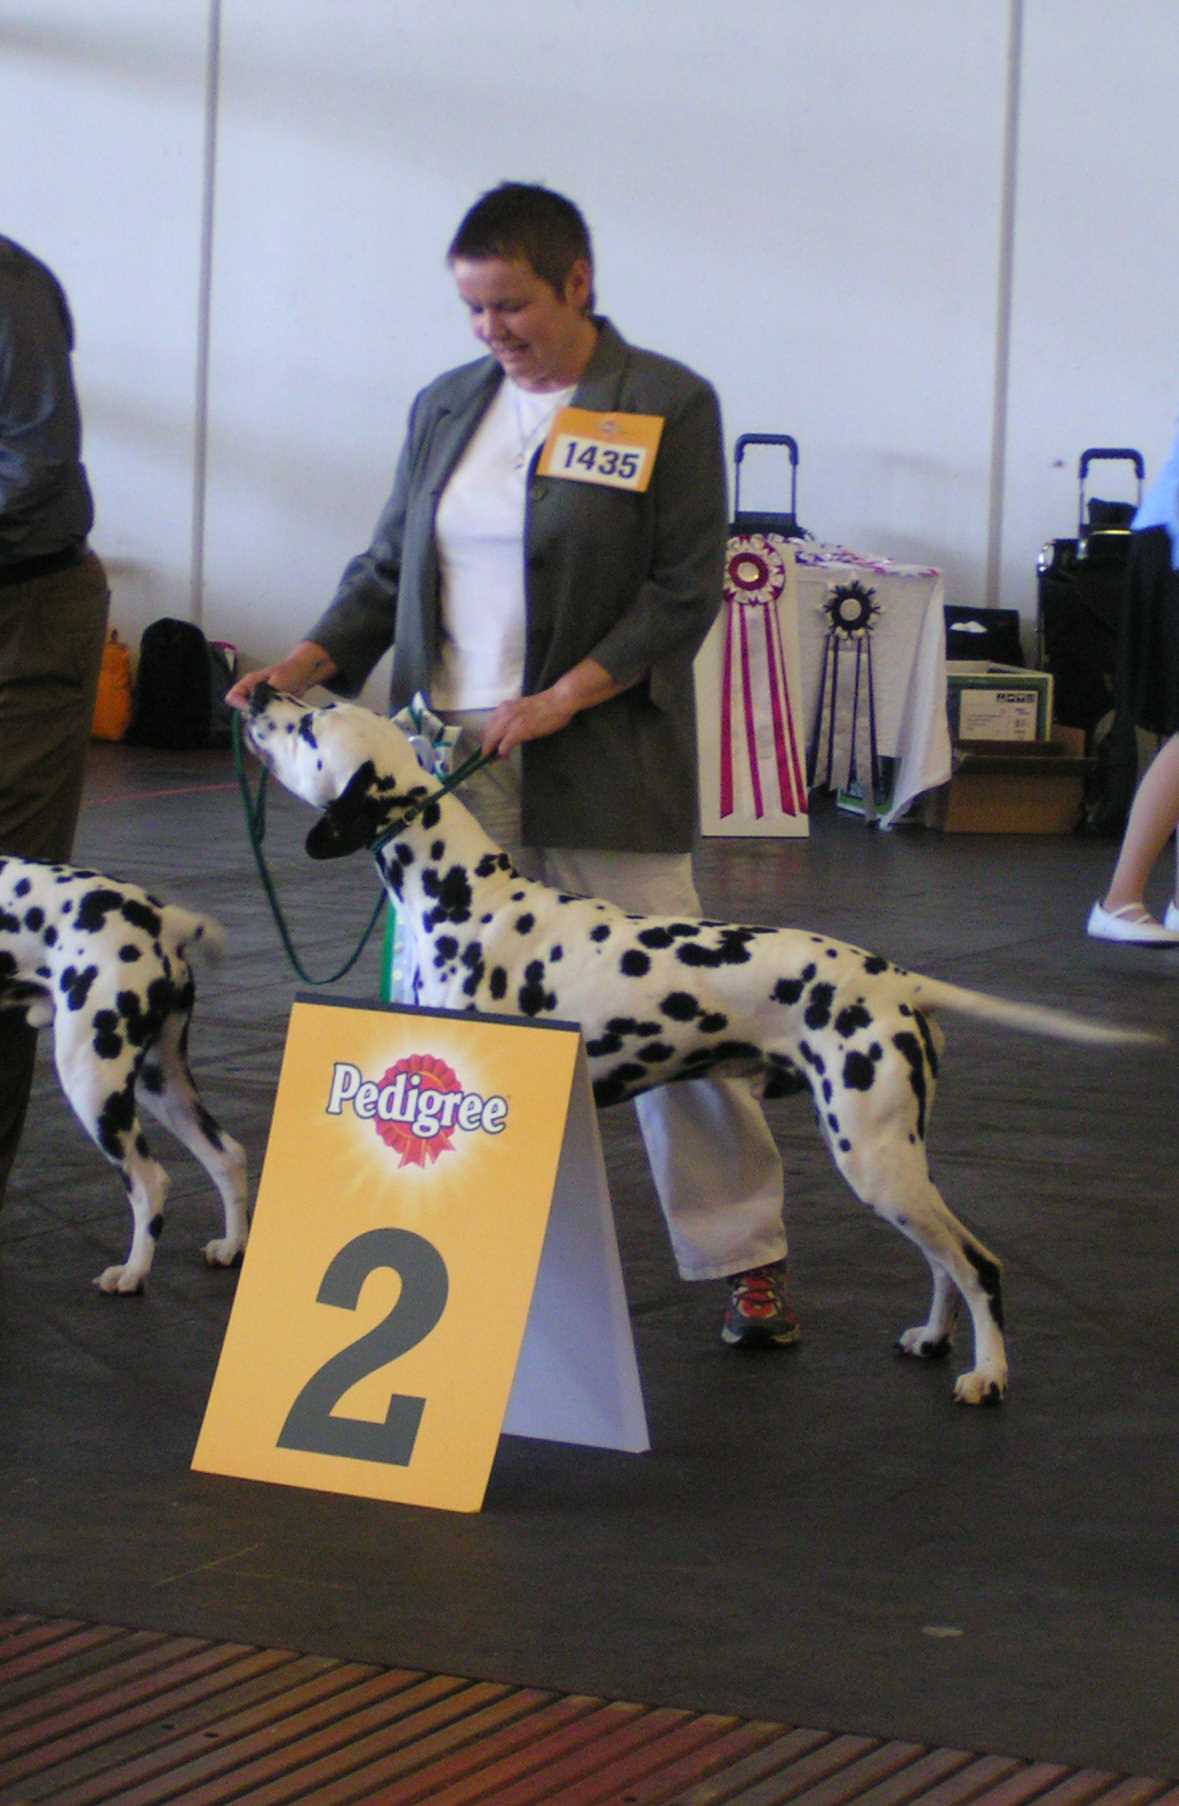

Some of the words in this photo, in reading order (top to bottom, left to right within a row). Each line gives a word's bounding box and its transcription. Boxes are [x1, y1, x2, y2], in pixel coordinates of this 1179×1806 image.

[564, 441, 640, 479] 1435
[326, 1062, 509, 1139] Pedigree
[276, 1227, 450, 1468] 2
